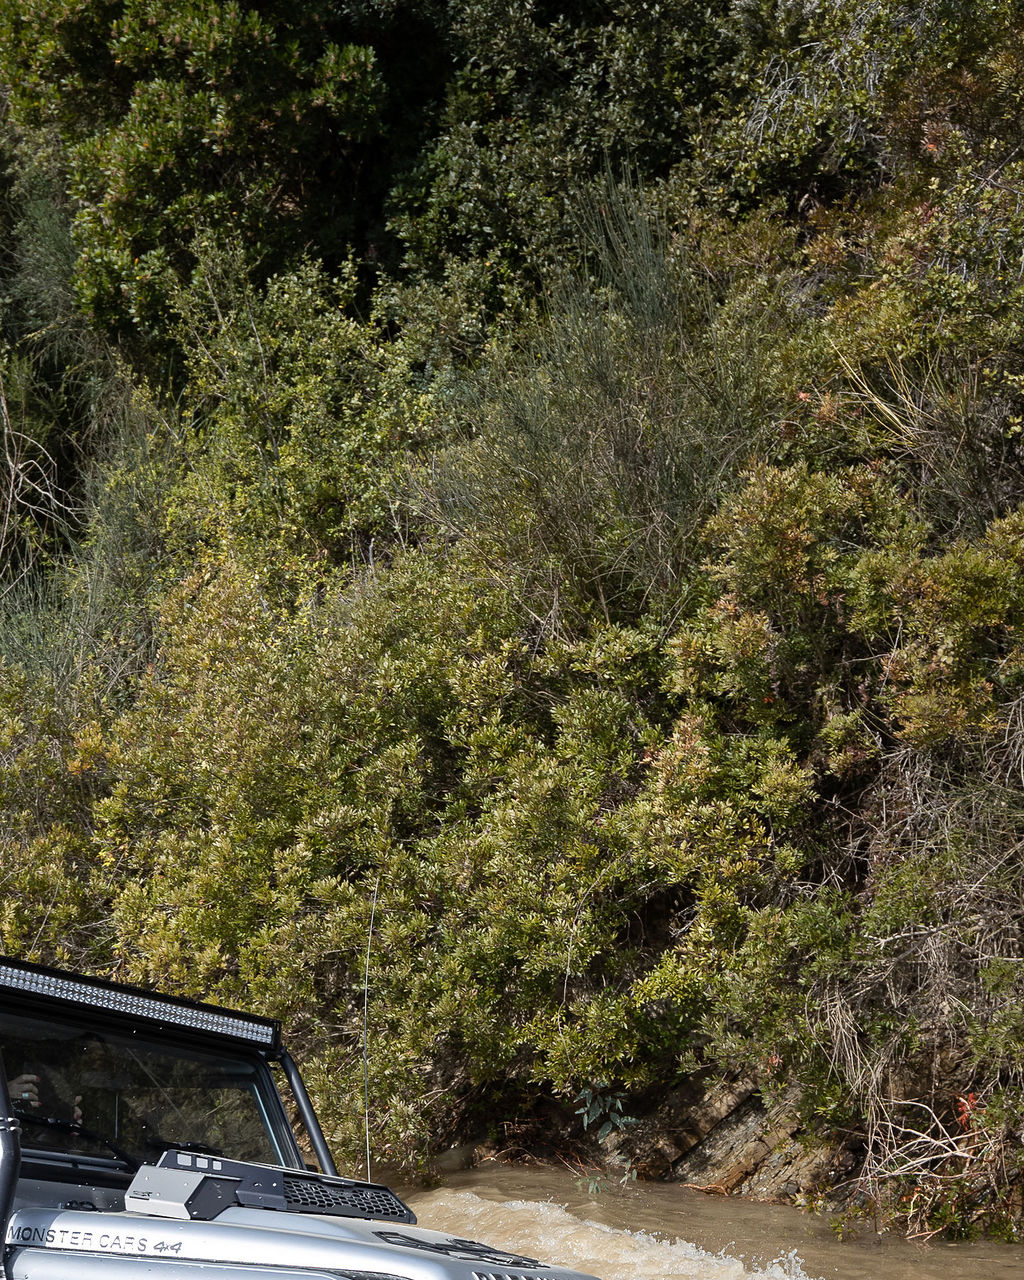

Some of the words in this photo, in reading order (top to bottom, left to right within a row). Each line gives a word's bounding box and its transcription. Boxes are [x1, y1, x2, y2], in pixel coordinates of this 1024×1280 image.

[7, 1225, 92, 1246] MONSTER
[99, 1234, 148, 1252] CARS
[153, 1241, 183, 1254] 4x4
